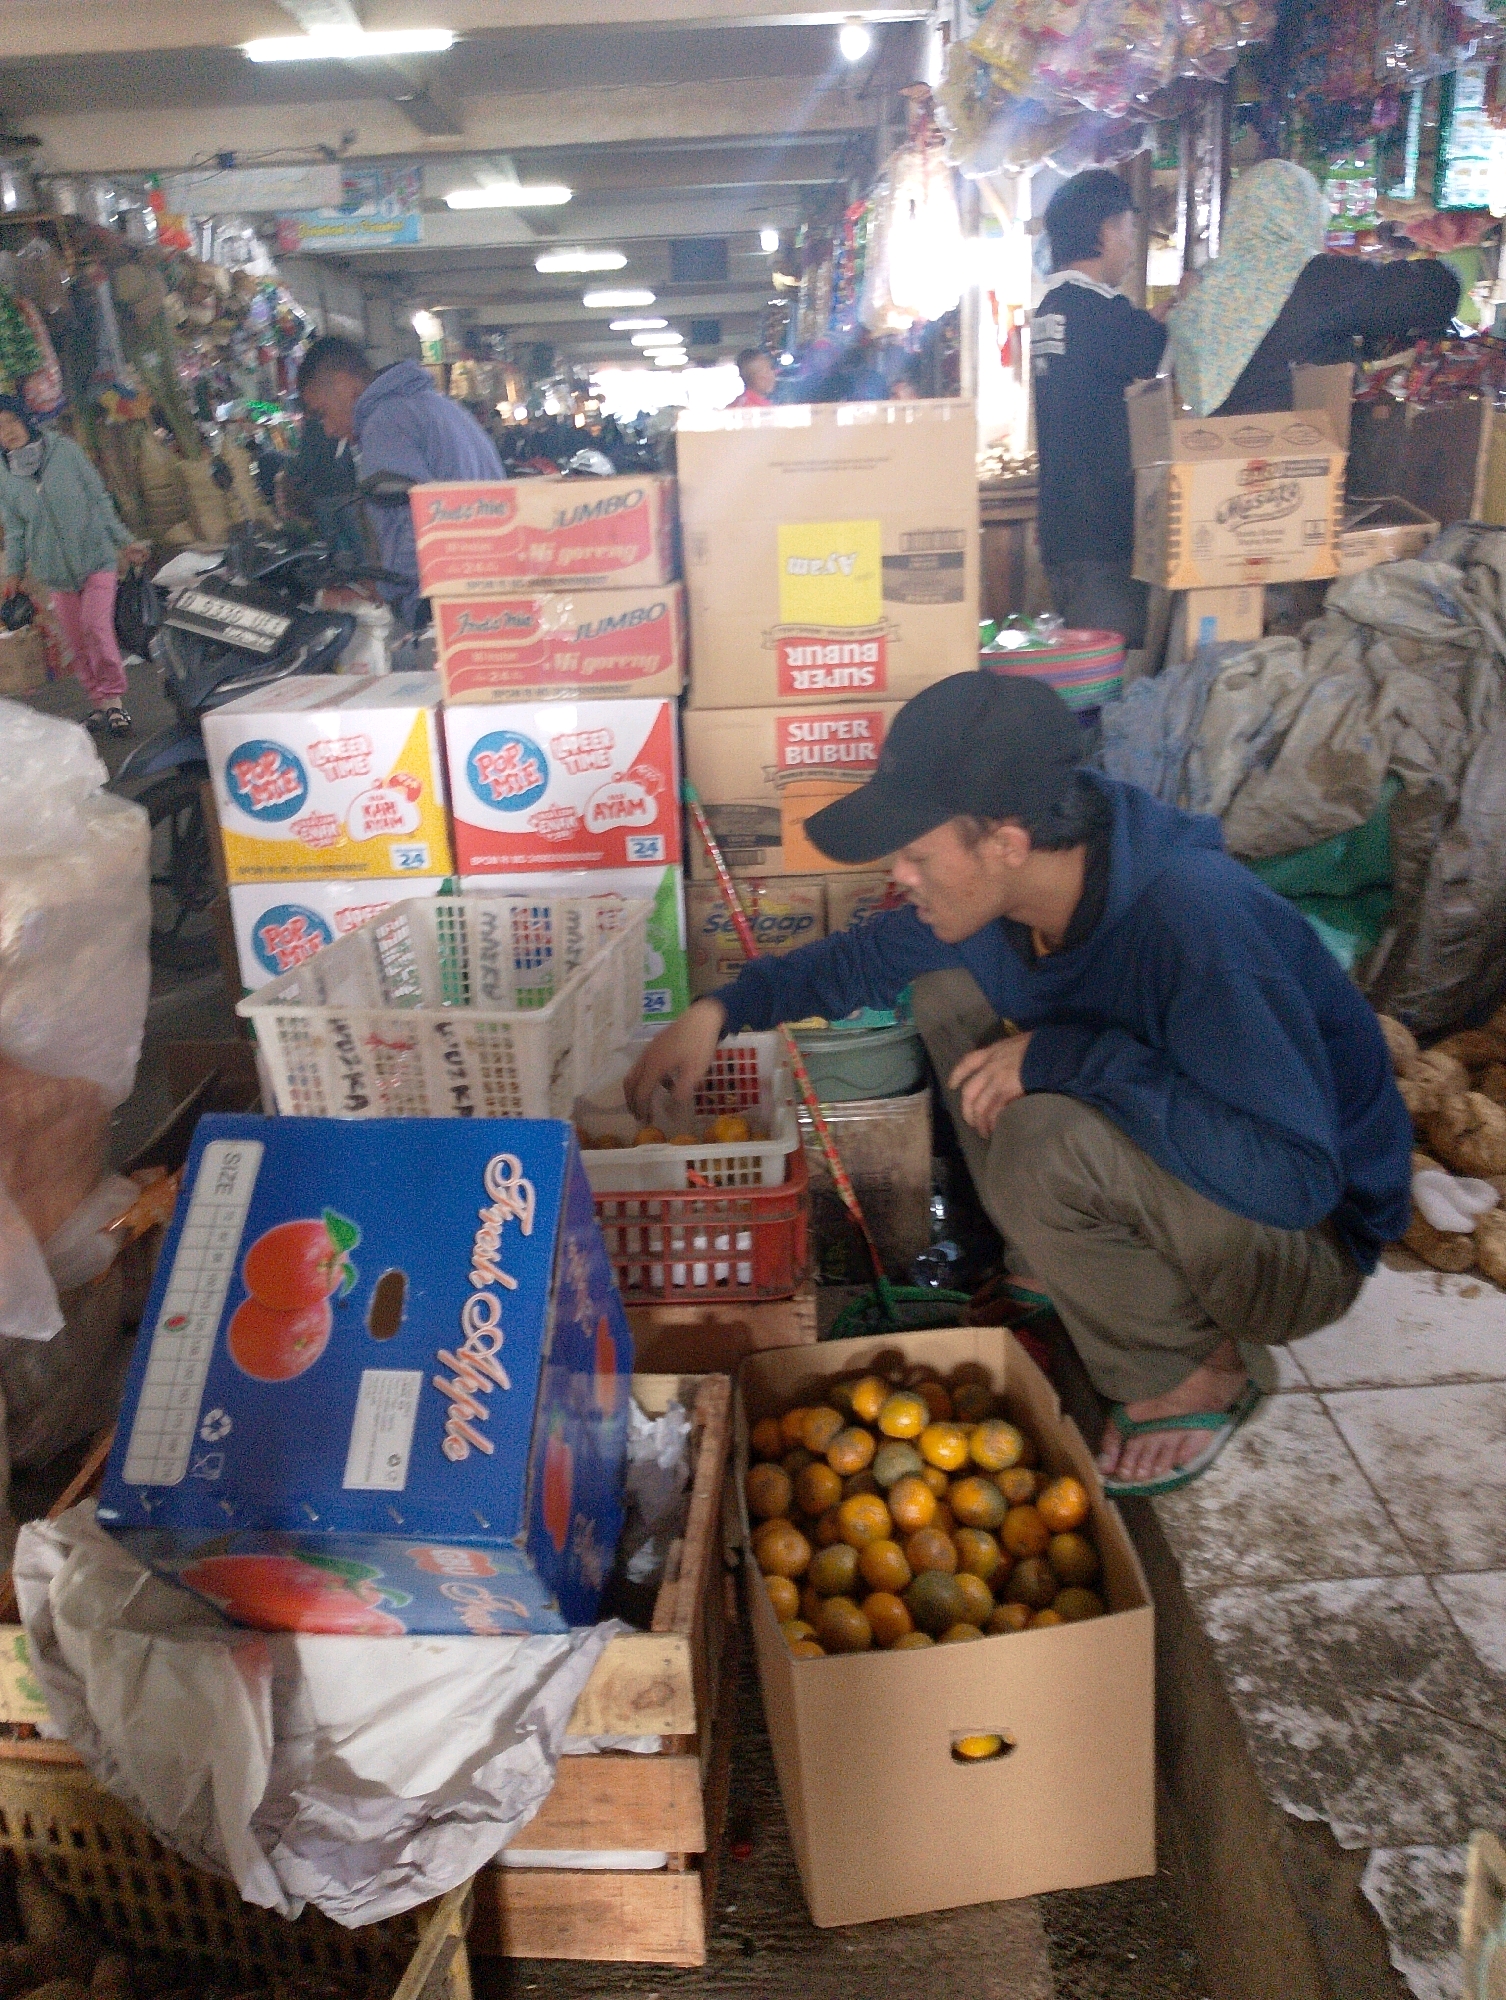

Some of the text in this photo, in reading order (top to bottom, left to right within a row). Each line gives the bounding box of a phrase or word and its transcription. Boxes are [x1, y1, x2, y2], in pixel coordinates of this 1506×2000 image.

[552, 489, 644, 530] JUMBO
[557, 544, 640, 567] goreng
[786, 552, 858, 577] Ayam
[572, 602, 668, 642] JUMBO
[553, 652, 661, 676] Mi goreng
[784, 642, 880, 667] BUBUR
[790, 666, 876, 690] SUPER
[787, 719, 873, 742] SUPER
[473, 742, 524, 784] POP
[785, 743, 879, 765] BUBUR
[231, 750, 281, 793] POP
[490, 759, 544, 801] MIE
[251, 767, 304, 810] MIE
[362, 801, 397, 817] KARI
[593, 798, 647, 822] AYAM
[399, 854, 425, 867] 24
[632, 841, 660, 855] 24
[259, 915, 308, 956] POP
[643, 996, 666, 1008] 24
[215, 1151, 241, 1195] SIZE
[468, 1153, 536, 1291] Fresh
[432, 1291, 511, 1462] Apple
